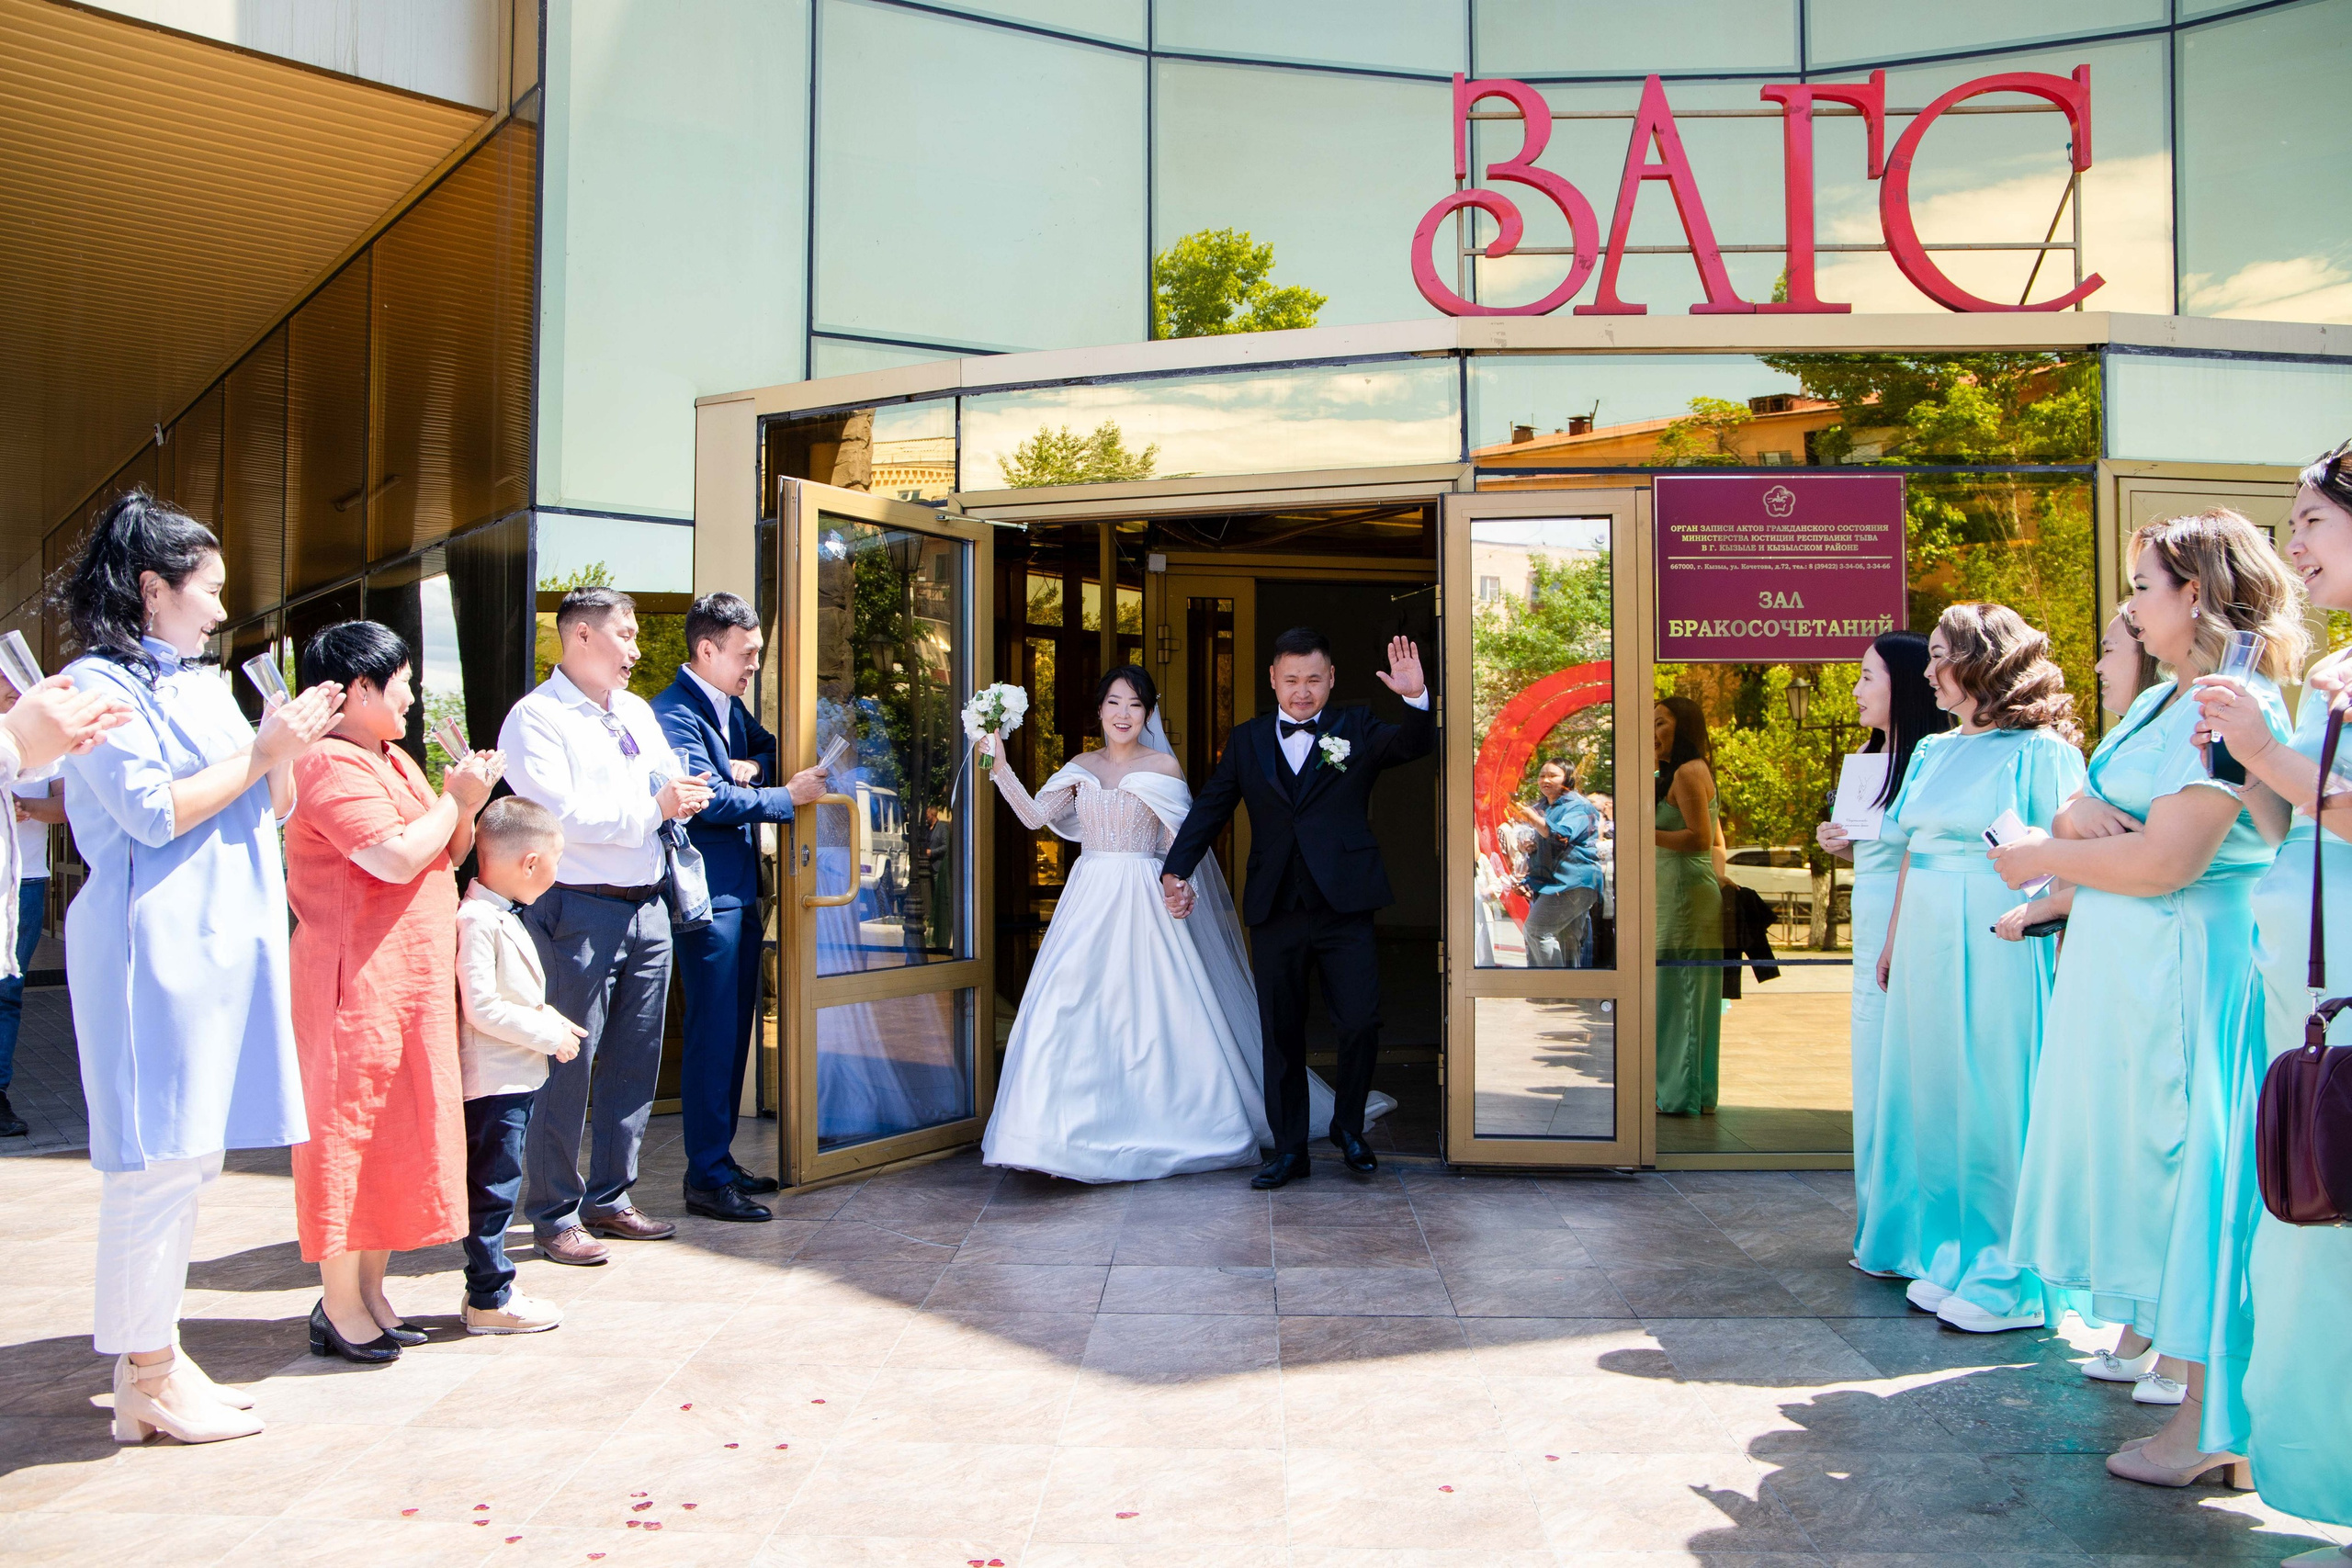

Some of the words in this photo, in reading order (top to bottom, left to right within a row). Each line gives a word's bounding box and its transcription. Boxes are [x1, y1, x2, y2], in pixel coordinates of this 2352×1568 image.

[1410, 63, 2107, 317] ЗАГС
[1825, 543, 1859, 551] РАЙОНЕ
[1815, 562, 1838, 570] (39422)
[1758, 592, 1804, 609] ЗАЛ
[1668, 614, 1894, 637] БРАКОСОЧЕТАНИЙ
